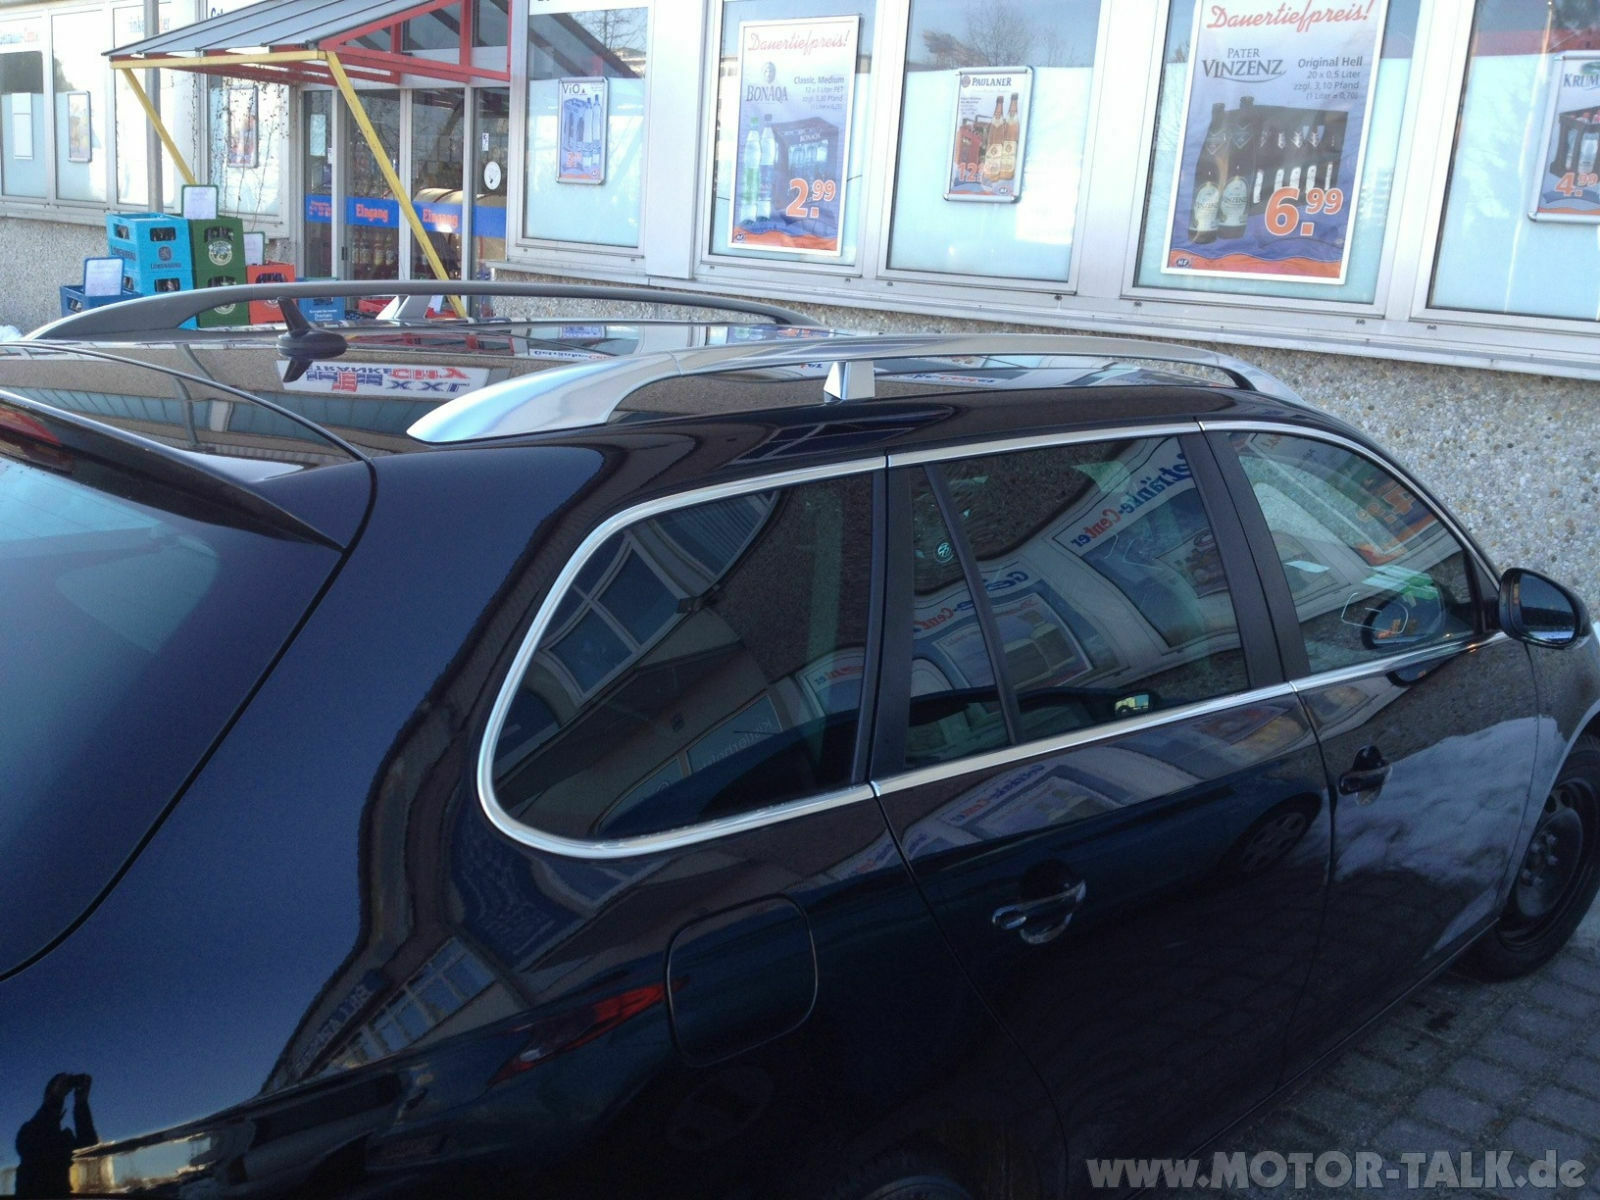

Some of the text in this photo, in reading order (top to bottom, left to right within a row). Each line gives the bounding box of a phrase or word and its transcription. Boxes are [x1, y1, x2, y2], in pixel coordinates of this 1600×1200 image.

[1206, 0, 1375, 33] Dauertiefpreis!
[748, 30, 850, 55] Dauertiefpreis!
[1227, 48, 1260, 58] PATER
[1202, 59, 1285, 78] VINZENZ
[1298, 56, 1363, 70] Original Hell
[972, 77, 1012, 87] PAULANER
[1307, 71, 1318, 79] 20
[1326, 71, 1340, 80] 0,5
[1341, 70, 1361, 79] Liter
[746, 85, 789, 103] BONAQA
[1335, 81, 1360, 90] Pfand
[1555, 172, 1599, 197] 4.99
[786, 177, 836, 219] 2.99
[356, 203, 389, 223] Eingang
[422, 208, 459, 228] Eingang
[1264, 186, 1344, 237] 6.99
